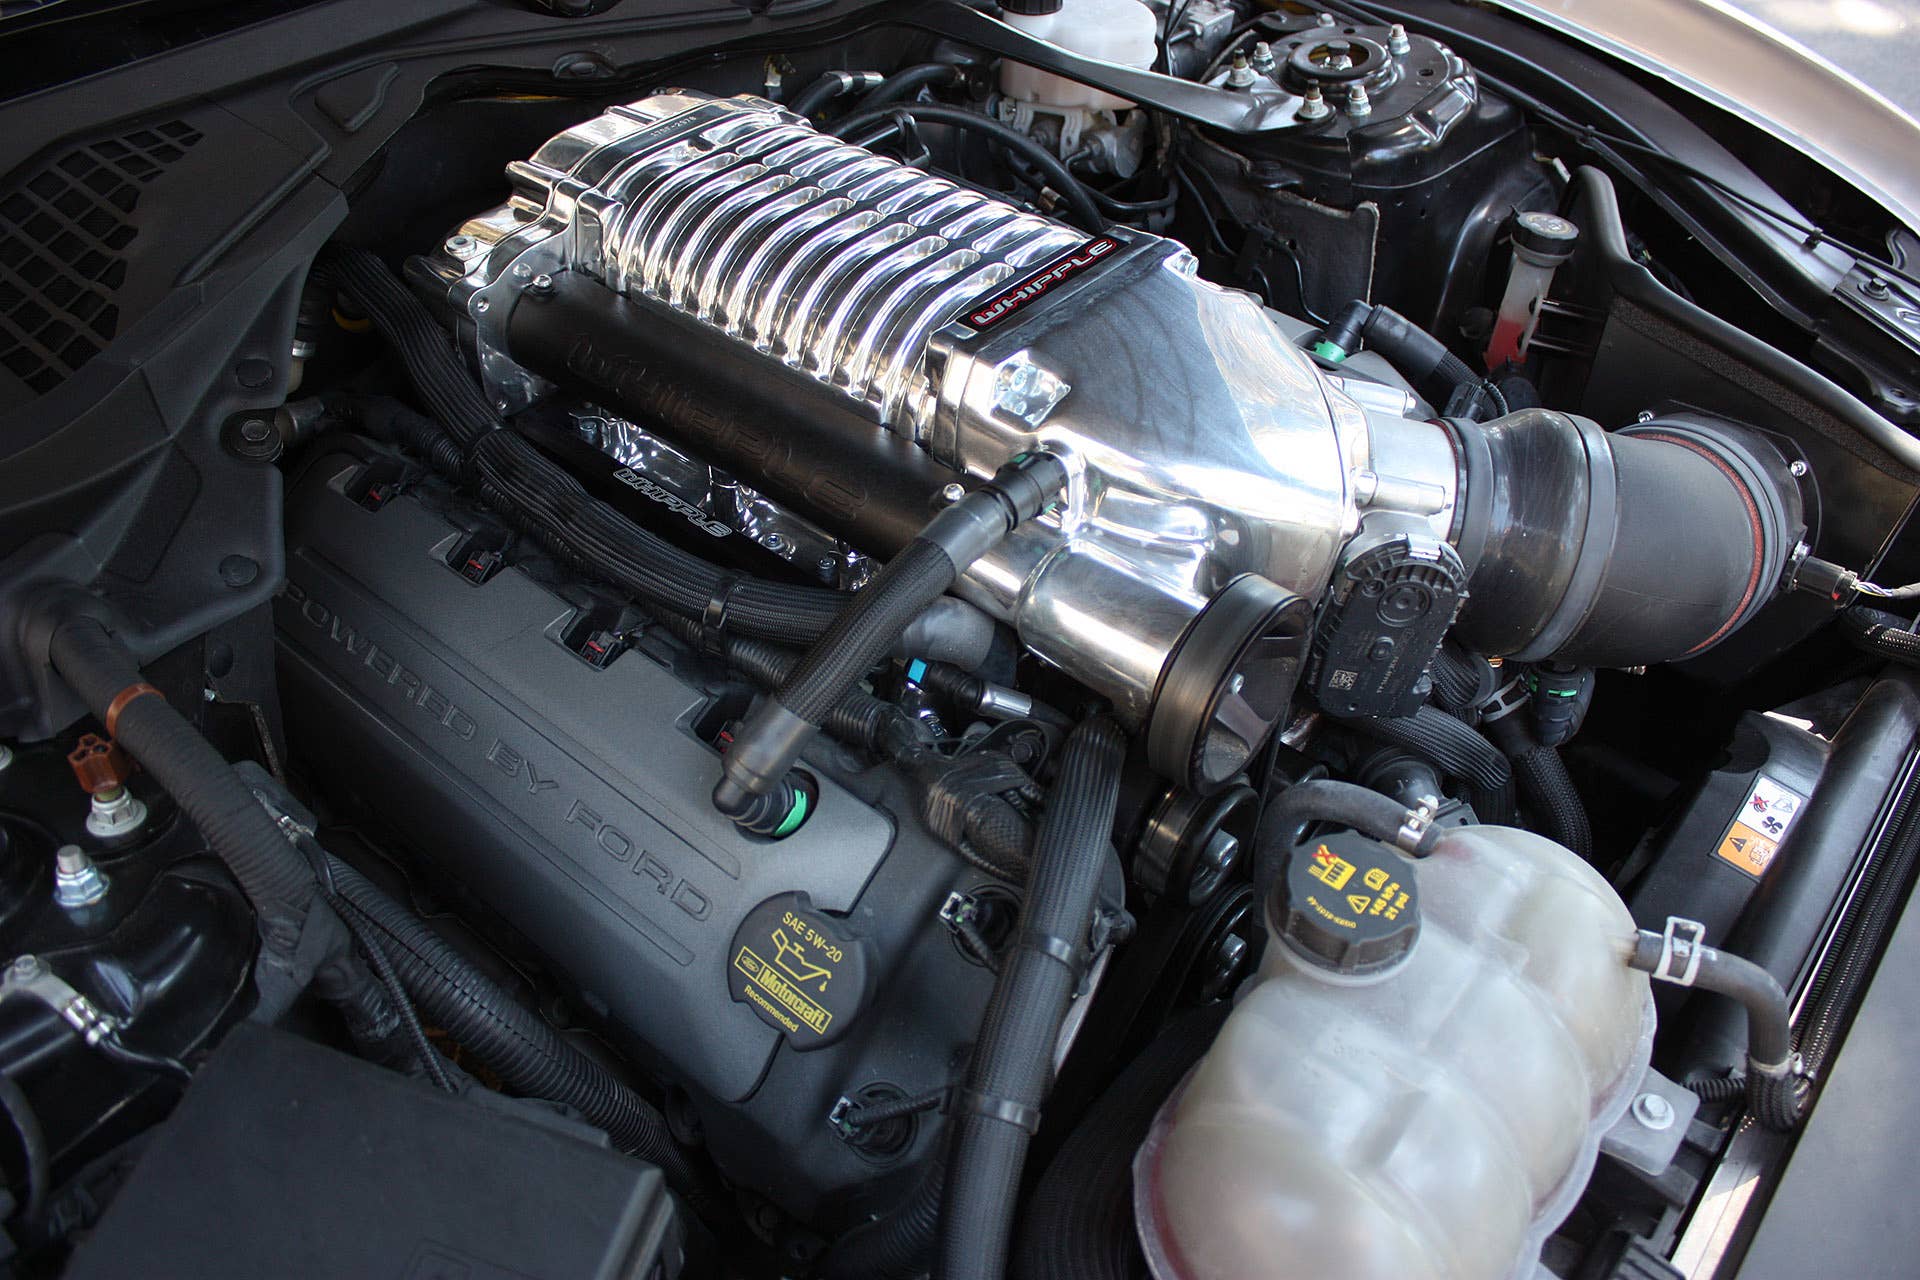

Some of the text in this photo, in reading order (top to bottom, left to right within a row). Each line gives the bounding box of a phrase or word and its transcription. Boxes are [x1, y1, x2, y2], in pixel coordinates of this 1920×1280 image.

[970, 238, 1117, 325] WHIPPLE
[613, 467, 733, 538] WHIPPLE
[486, 738, 560, 795] BY
[562, 799, 713, 922] FORD
[782, 911, 843, 964] SAE 5W-20
[743, 984, 800, 1033] Recommended
